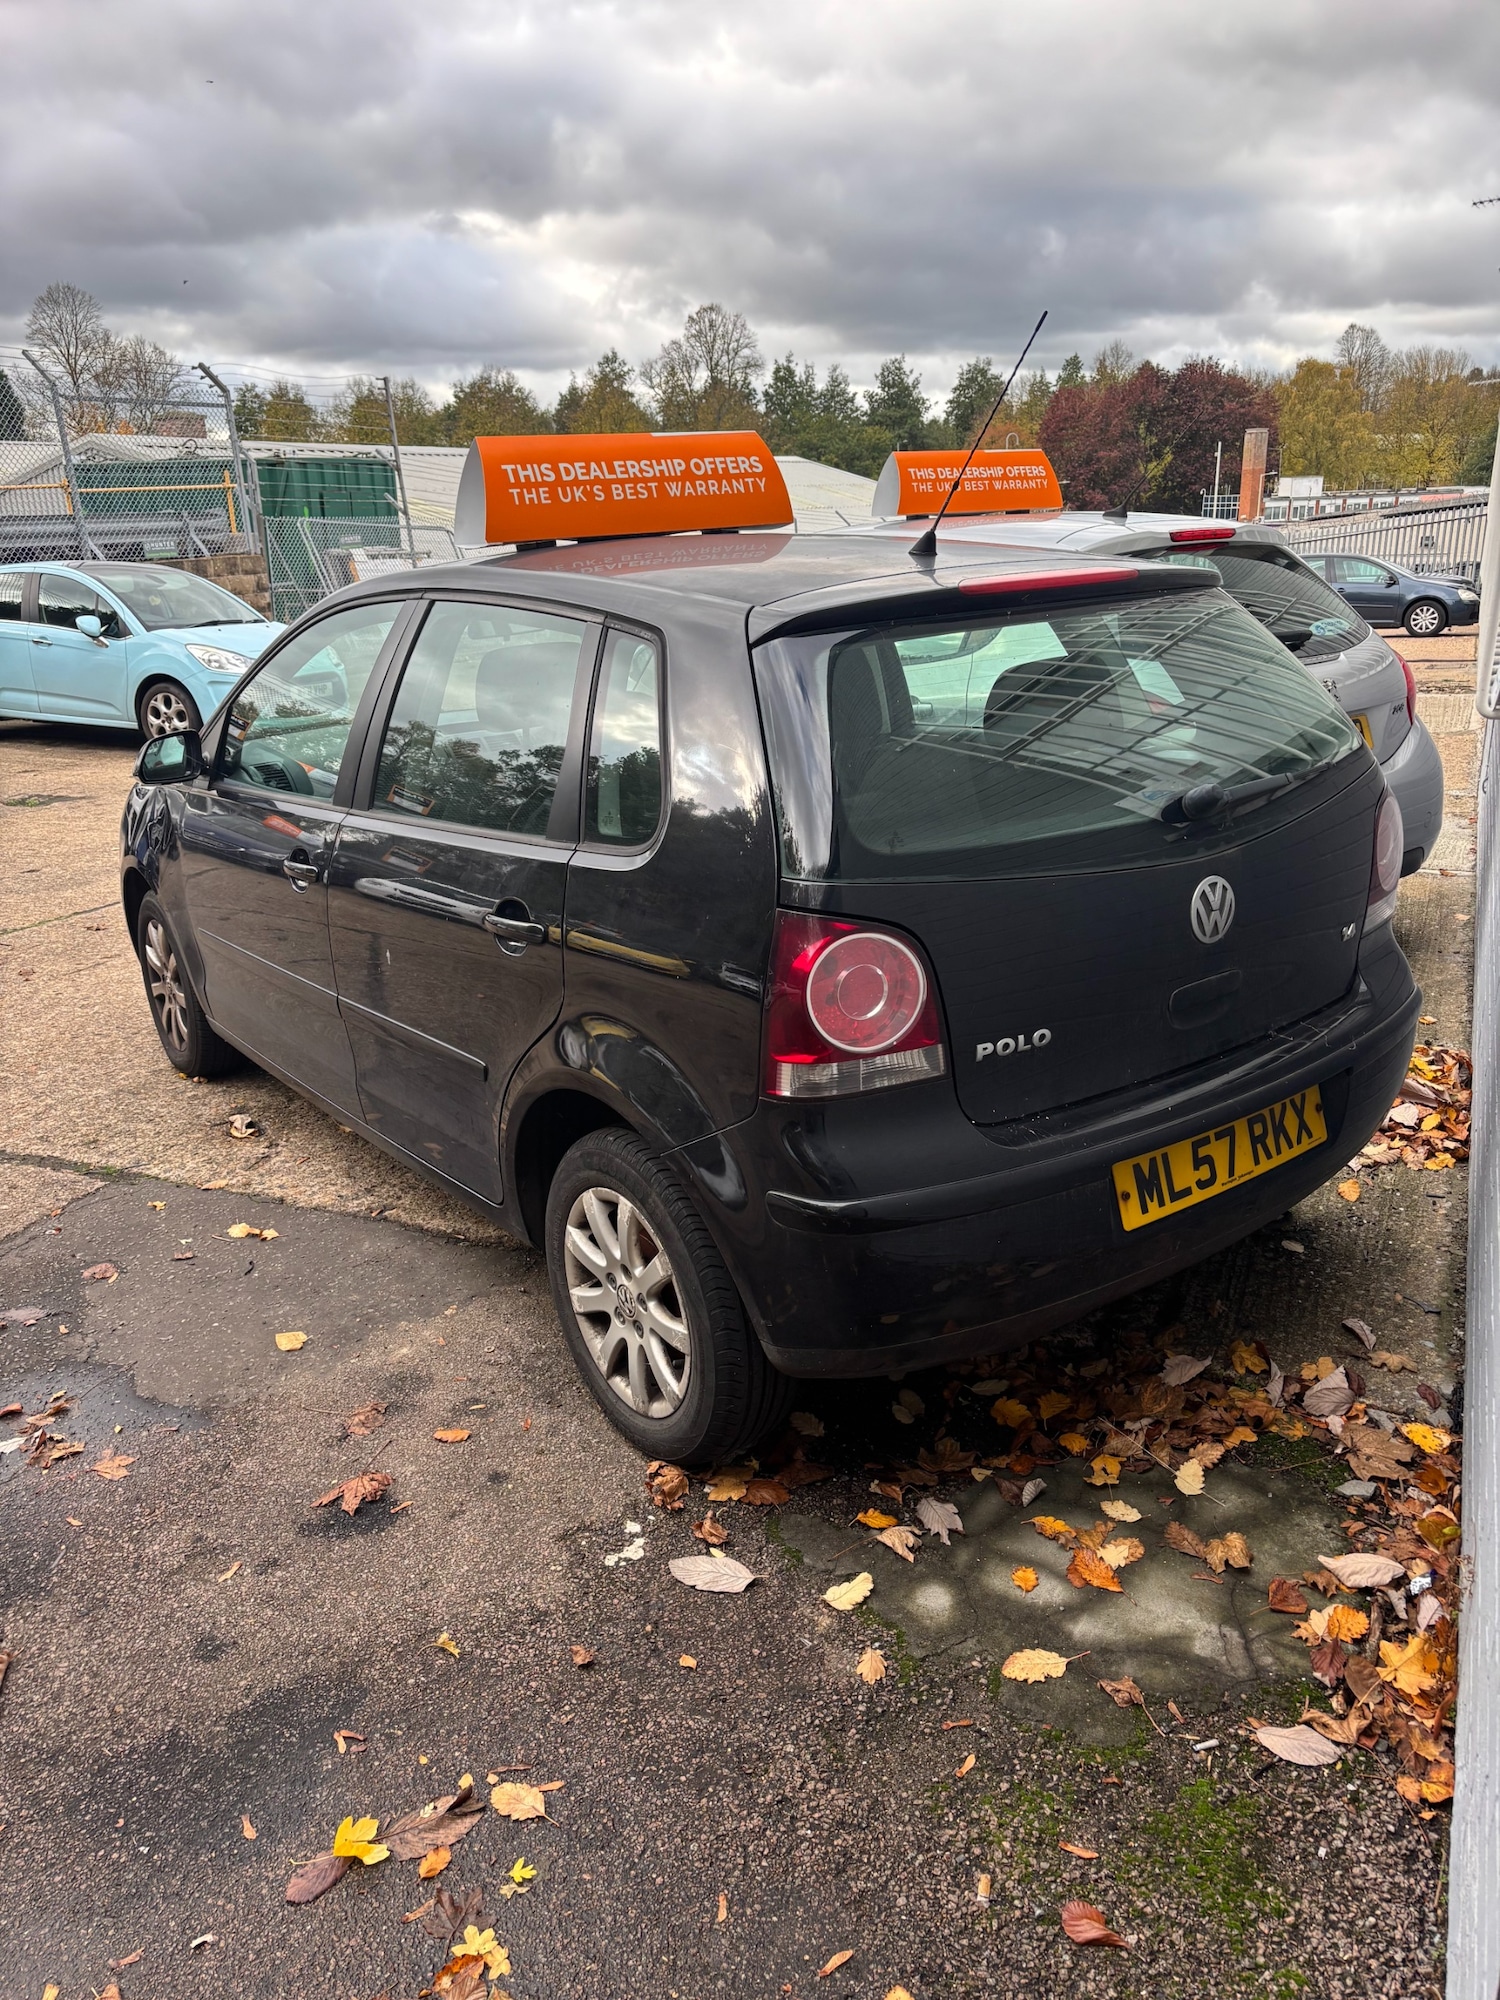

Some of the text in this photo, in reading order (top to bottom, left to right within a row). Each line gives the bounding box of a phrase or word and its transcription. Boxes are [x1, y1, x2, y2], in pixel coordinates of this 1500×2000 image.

[501, 456, 763, 483] THIS DEALERSHIP OFFERS
[908, 465, 1046, 480] THIS DEALERSHIP OFFERS
[509, 477, 766, 505] THE UK'S BEST WARRANTY
[911, 482, 934, 493] THE
[964, 480, 989, 491] BEST
[992, 479, 1048, 491] WARRANTY
[975, 1028, 1052, 1063] POLO
[1132, 1093, 1313, 1215] ML57 RKX
